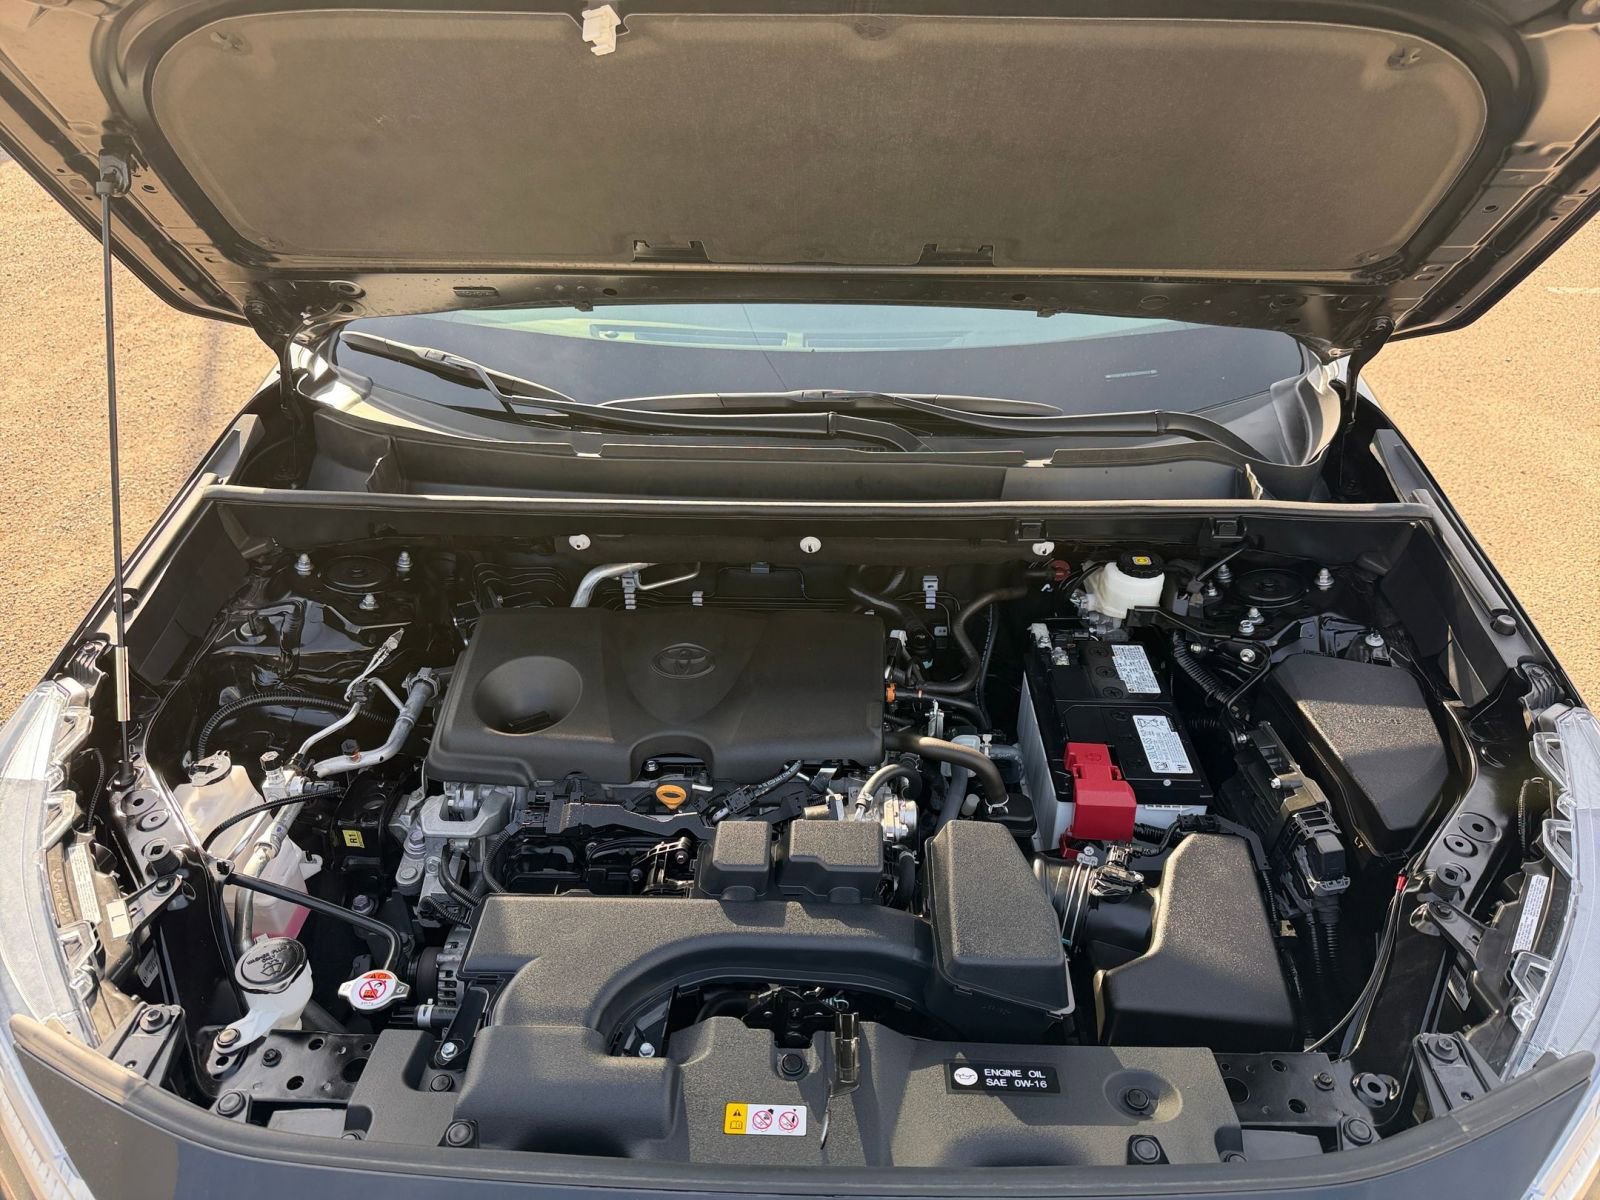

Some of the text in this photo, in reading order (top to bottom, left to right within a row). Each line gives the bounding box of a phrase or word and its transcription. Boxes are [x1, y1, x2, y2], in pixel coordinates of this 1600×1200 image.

[984, 1068, 1046, 1079] ENGINE OIL
[986, 1078, 1048, 1088] SAE 0W-16
